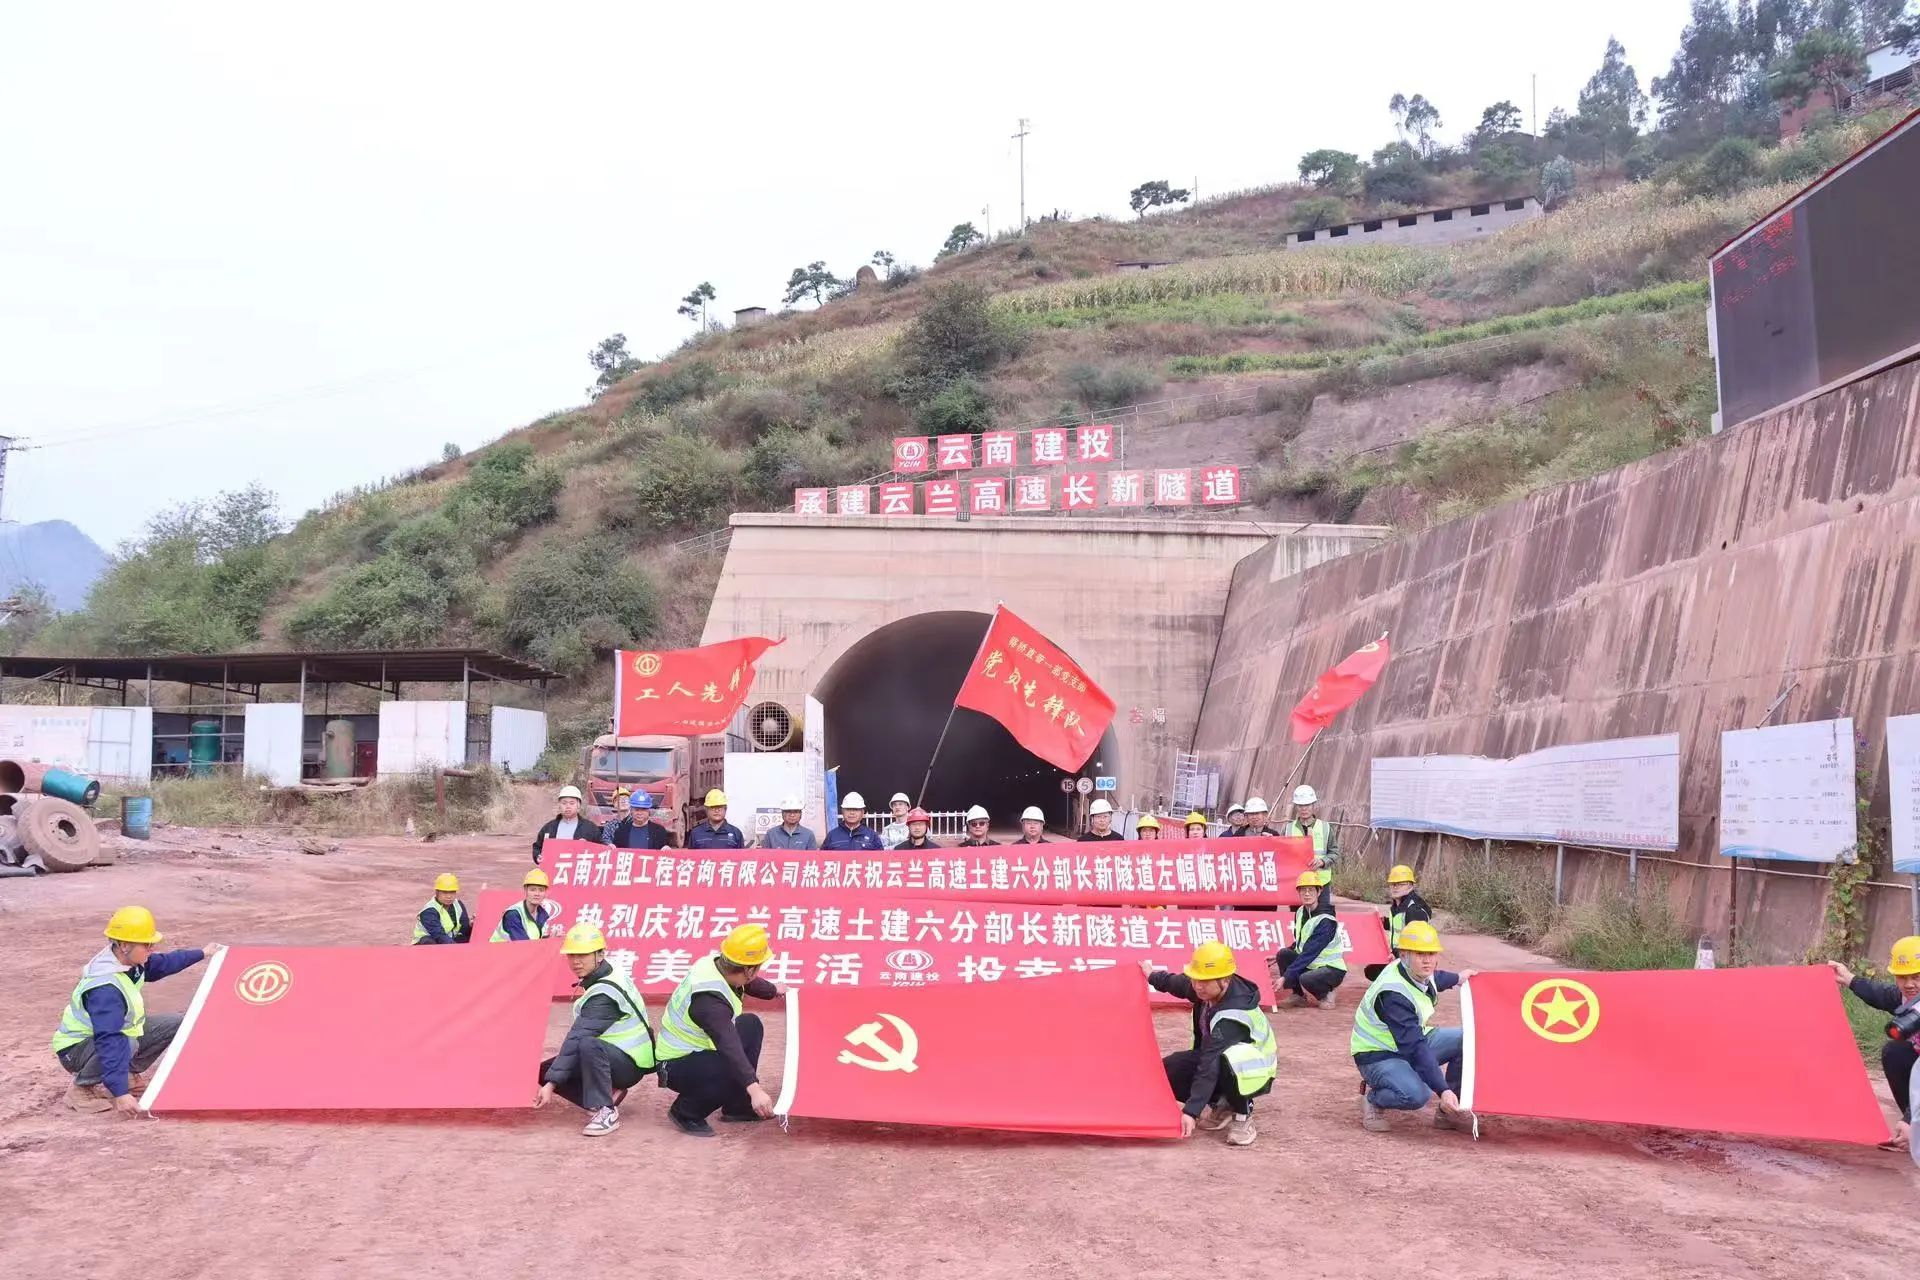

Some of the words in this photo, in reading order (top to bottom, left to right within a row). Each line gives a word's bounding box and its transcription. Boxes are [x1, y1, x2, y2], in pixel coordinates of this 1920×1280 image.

[941, 428, 1110, 465] 云南建投
[800, 470, 1237, 514] 承建云兰高速长新隧道
[981, 650, 1086, 736] 党员先锋队
[1063, 780, 1074, 791] 15
[553, 850, 1278, 893] 云南升盟工程咨询有限公司热烈庆祝云兰高速土建六分部长新隧道左幅顺利贯通
[575, 903, 1353, 952] 热烈庆祝云兰高速土建六分部长新隧道左幅顺利通
